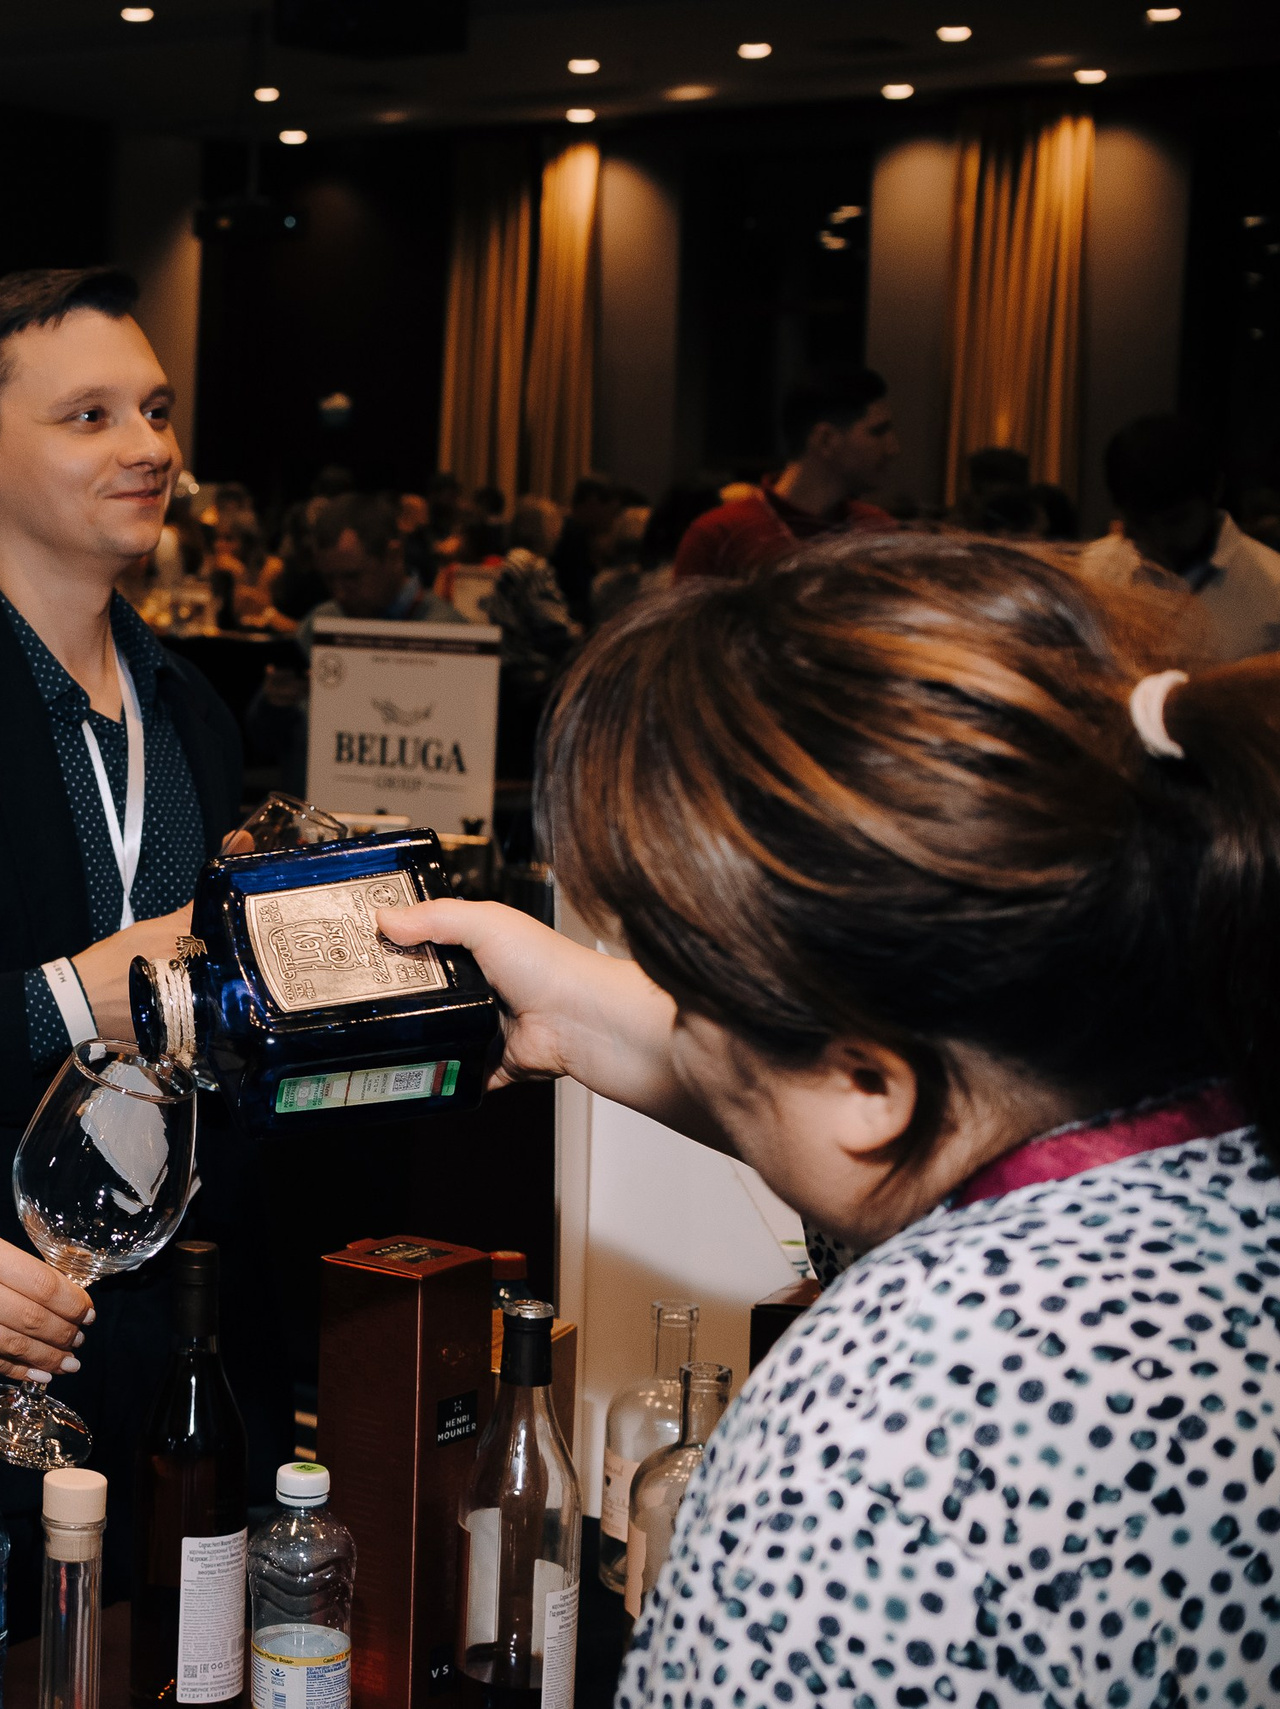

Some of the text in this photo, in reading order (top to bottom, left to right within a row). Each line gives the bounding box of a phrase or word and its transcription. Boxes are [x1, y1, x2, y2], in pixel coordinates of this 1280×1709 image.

[334, 730, 467, 775] BELUGA
[351, 889, 377, 940] Premium
[323, 922, 346, 944] 925
[274, 930, 296, 971] TEQUILA
[291, 930, 327, 965] Ley
[406, 966, 417, 978] DE
[414, 959, 430, 982] AGAVE
[294, 983, 306, 998] NET
[437, 1422, 477, 1442] MOUNIER
[445, 1414, 470, 1428] HENRI
